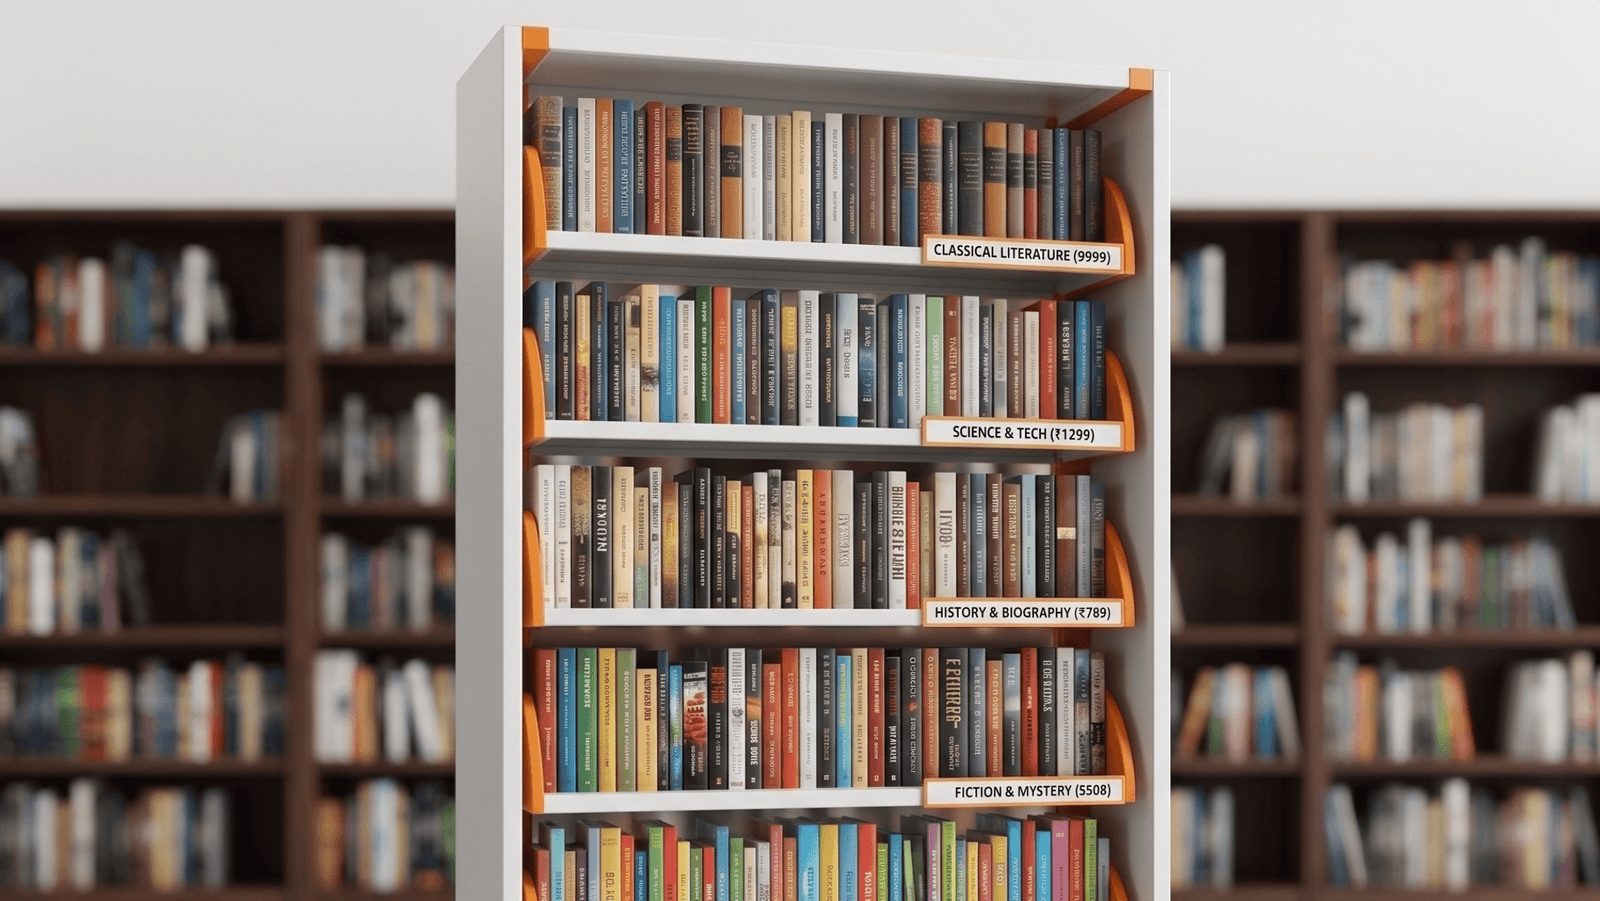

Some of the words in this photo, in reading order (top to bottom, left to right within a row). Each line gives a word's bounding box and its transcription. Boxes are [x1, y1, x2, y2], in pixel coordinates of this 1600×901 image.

[934, 244, 997, 258] CLASSICAL
[1000, 247, 1070, 261] LITERATURE
[1073, 250, 1111, 265] (9999)
[953, 426, 1001, 438] SCIENCE
[1005, 427, 1014, 439] &
[1017, 428, 1047, 440] TECH
[935, 607, 986, 618] HISTORY
[990, 607, 998, 618] &
[1002, 607, 1071, 618] BIOGRAPHY
[955, 787, 1002, 798] FICTION
[1005, 786, 1014, 797] &
[1018, 785, 1072, 797] MYSTERY
[1075, 784, 1111, 798] (5508)
